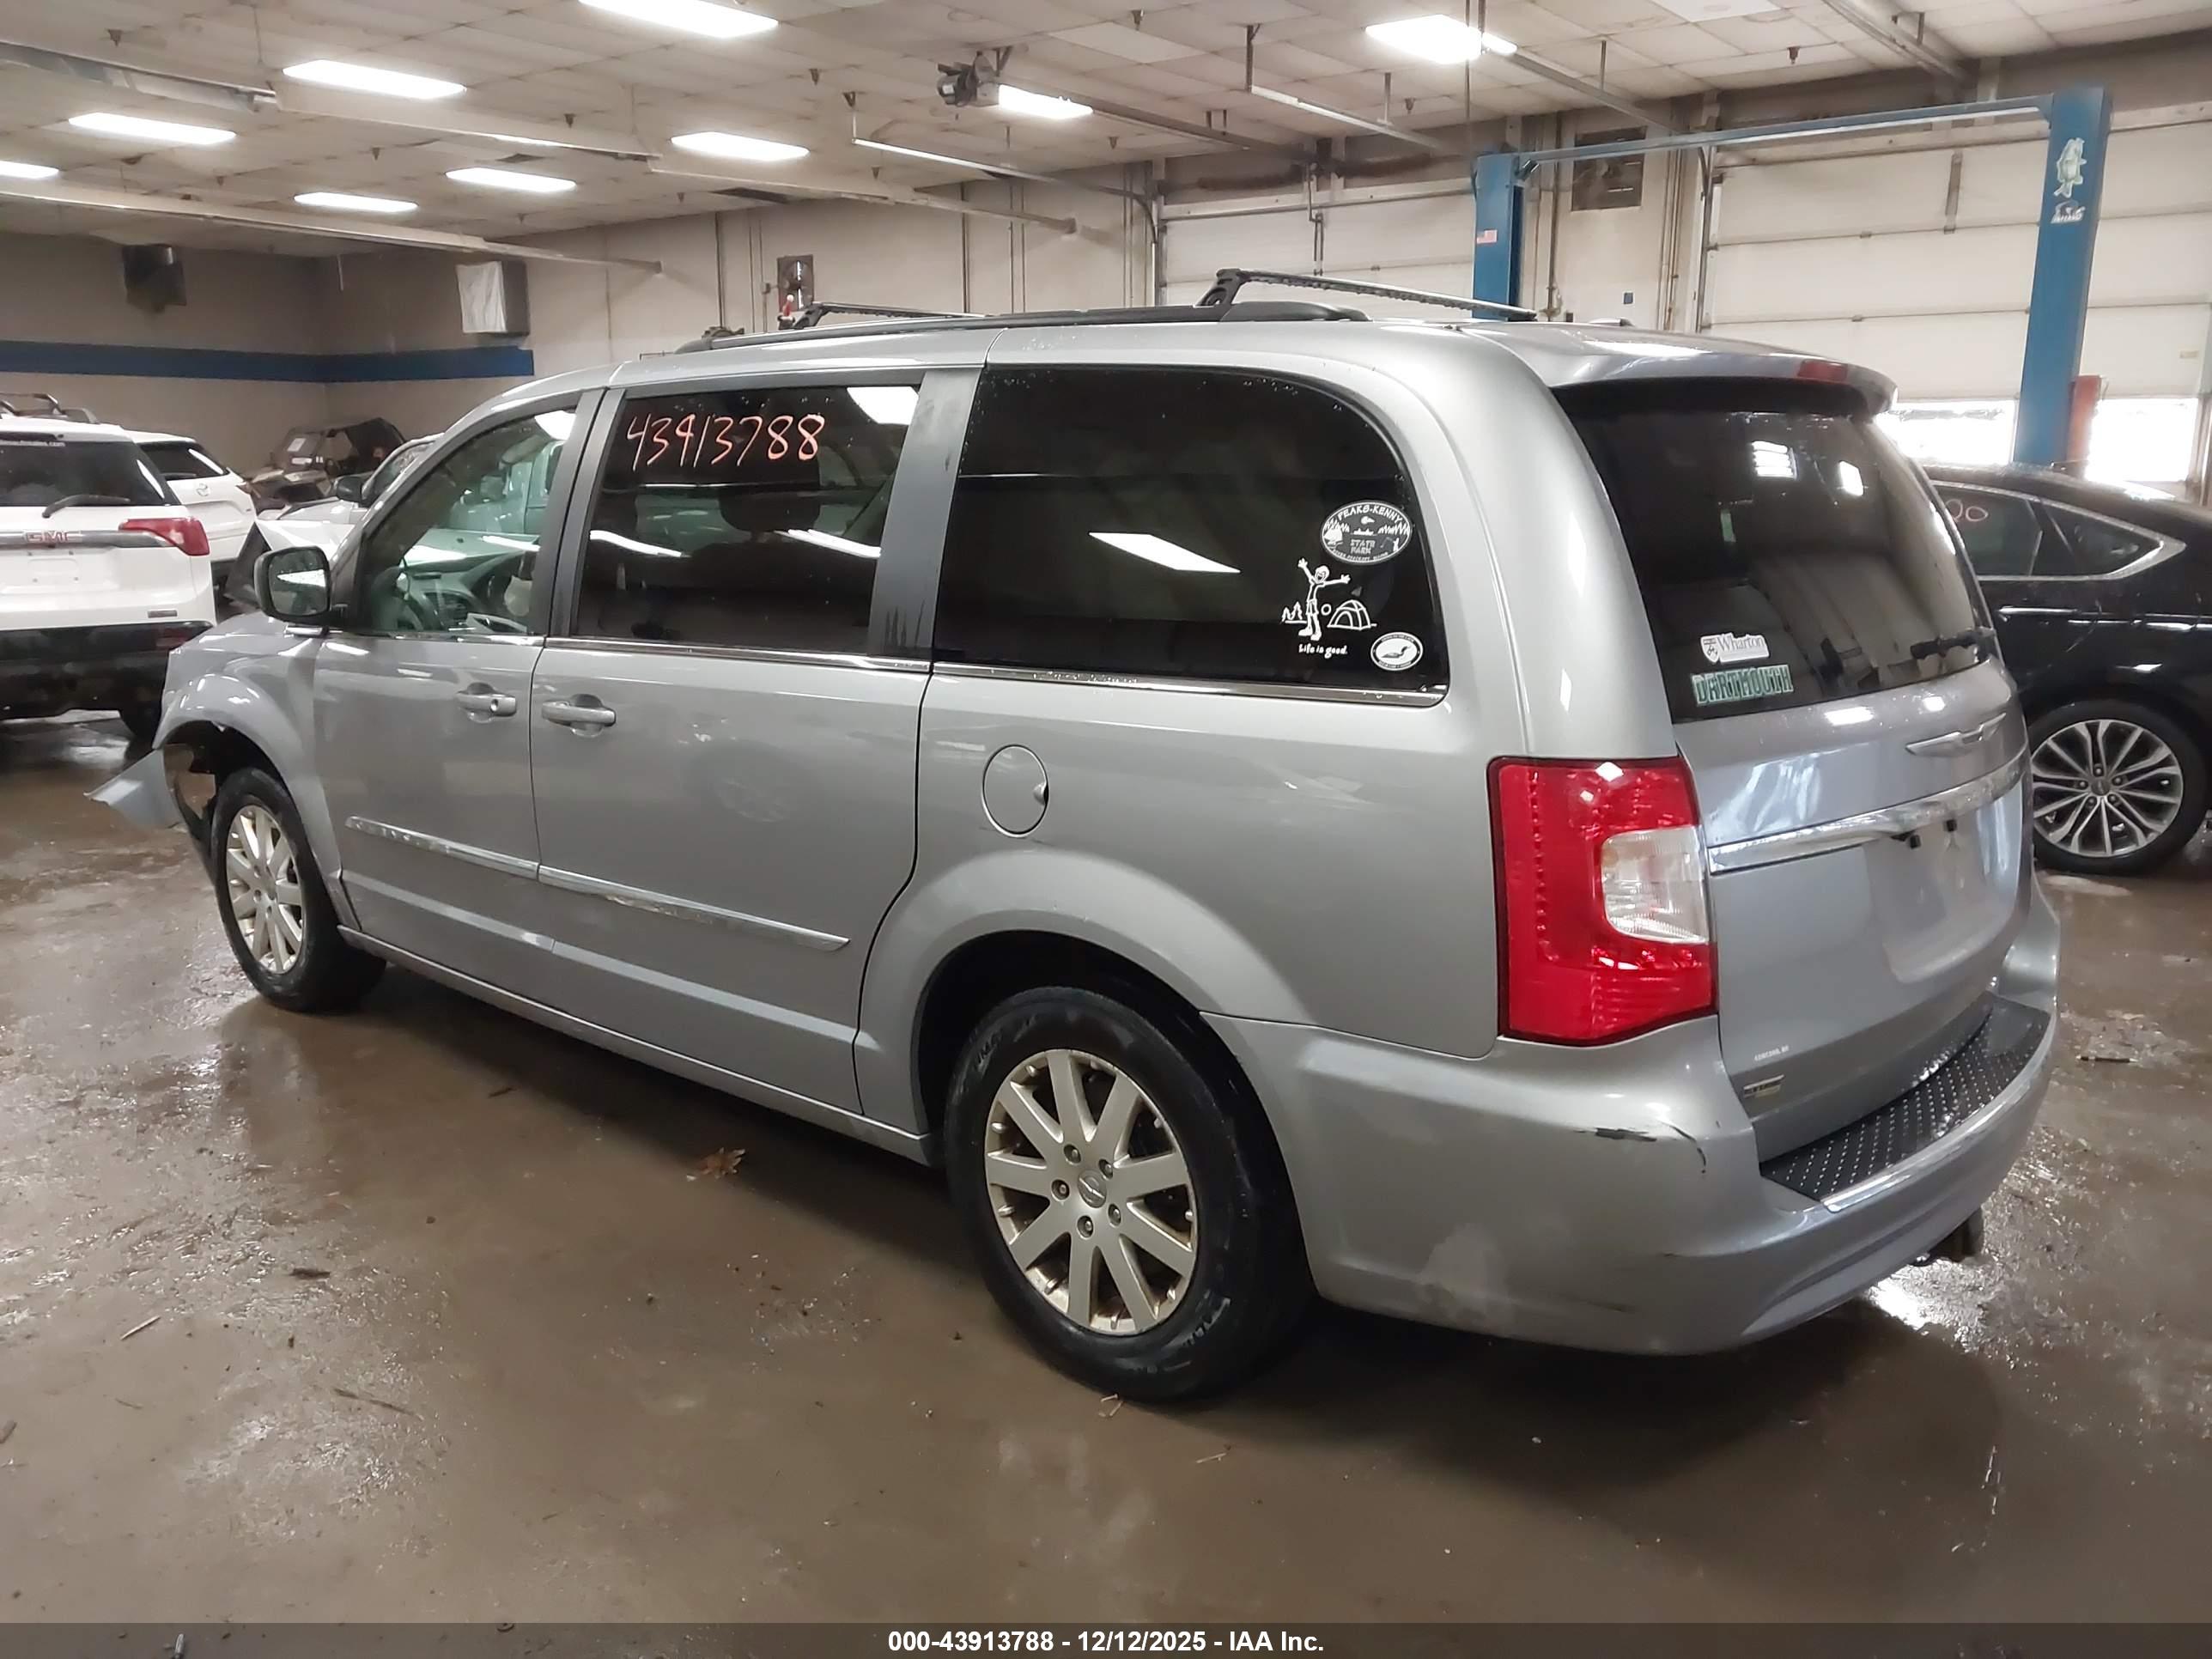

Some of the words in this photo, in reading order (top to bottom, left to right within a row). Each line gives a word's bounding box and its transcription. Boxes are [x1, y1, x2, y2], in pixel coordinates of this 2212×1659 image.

[626, 413, 825, 471] 43913788
[25, 530, 83, 544] GMC
[1298, 643, 1315, 654] Life
[1316, 645, 1324, 653] is
[1717, 635, 1765, 652] Wharton
[1692, 665, 1794, 704] DARTMOUTH
